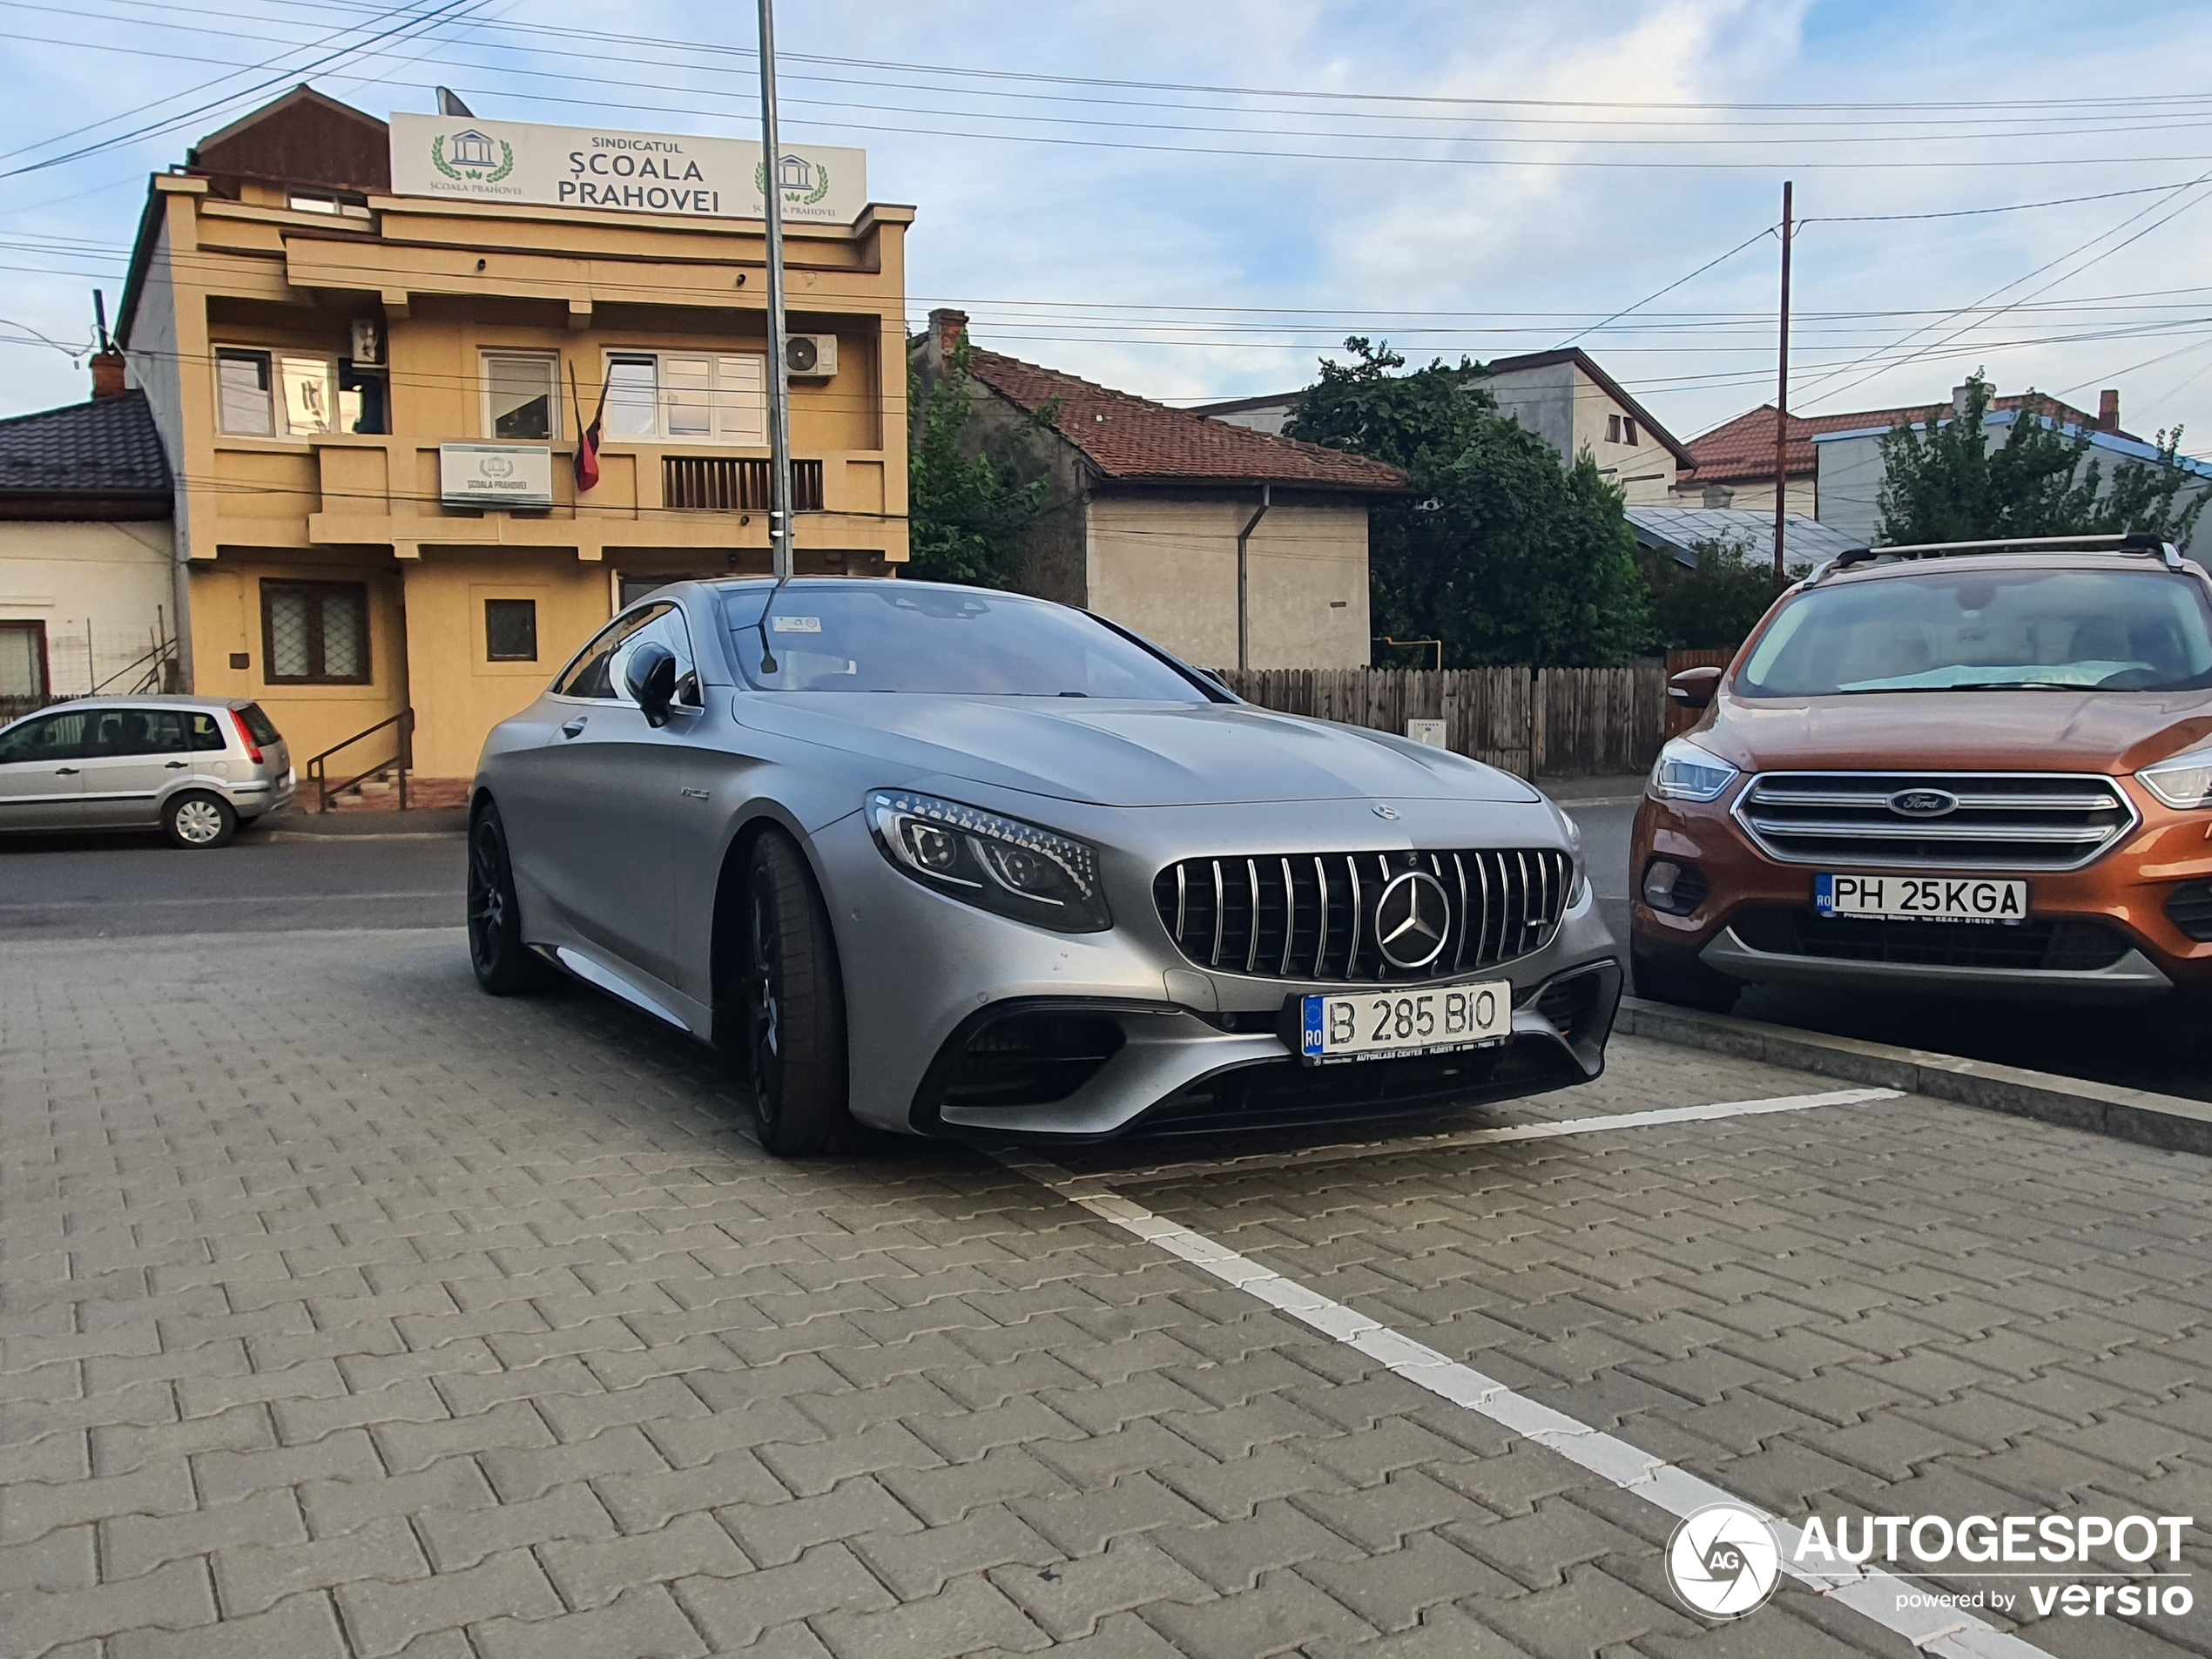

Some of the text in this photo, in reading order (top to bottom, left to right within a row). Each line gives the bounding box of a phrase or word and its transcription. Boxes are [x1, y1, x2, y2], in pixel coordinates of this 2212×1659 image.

[591, 137, 684, 153] SINDICATUL
[569, 152, 705, 182] ȘCOALA
[471, 185, 523, 195] PRAHOVEI
[558, 180, 718, 212] PRAHOVEI
[752, 203, 836, 217] ȘCA PRAHOVEI
[1903, 794, 1939, 810] Ford
[1817, 878, 2020, 914] RO PH 25KGA
[1305, 989, 1496, 1048] RO B 285 BIO
